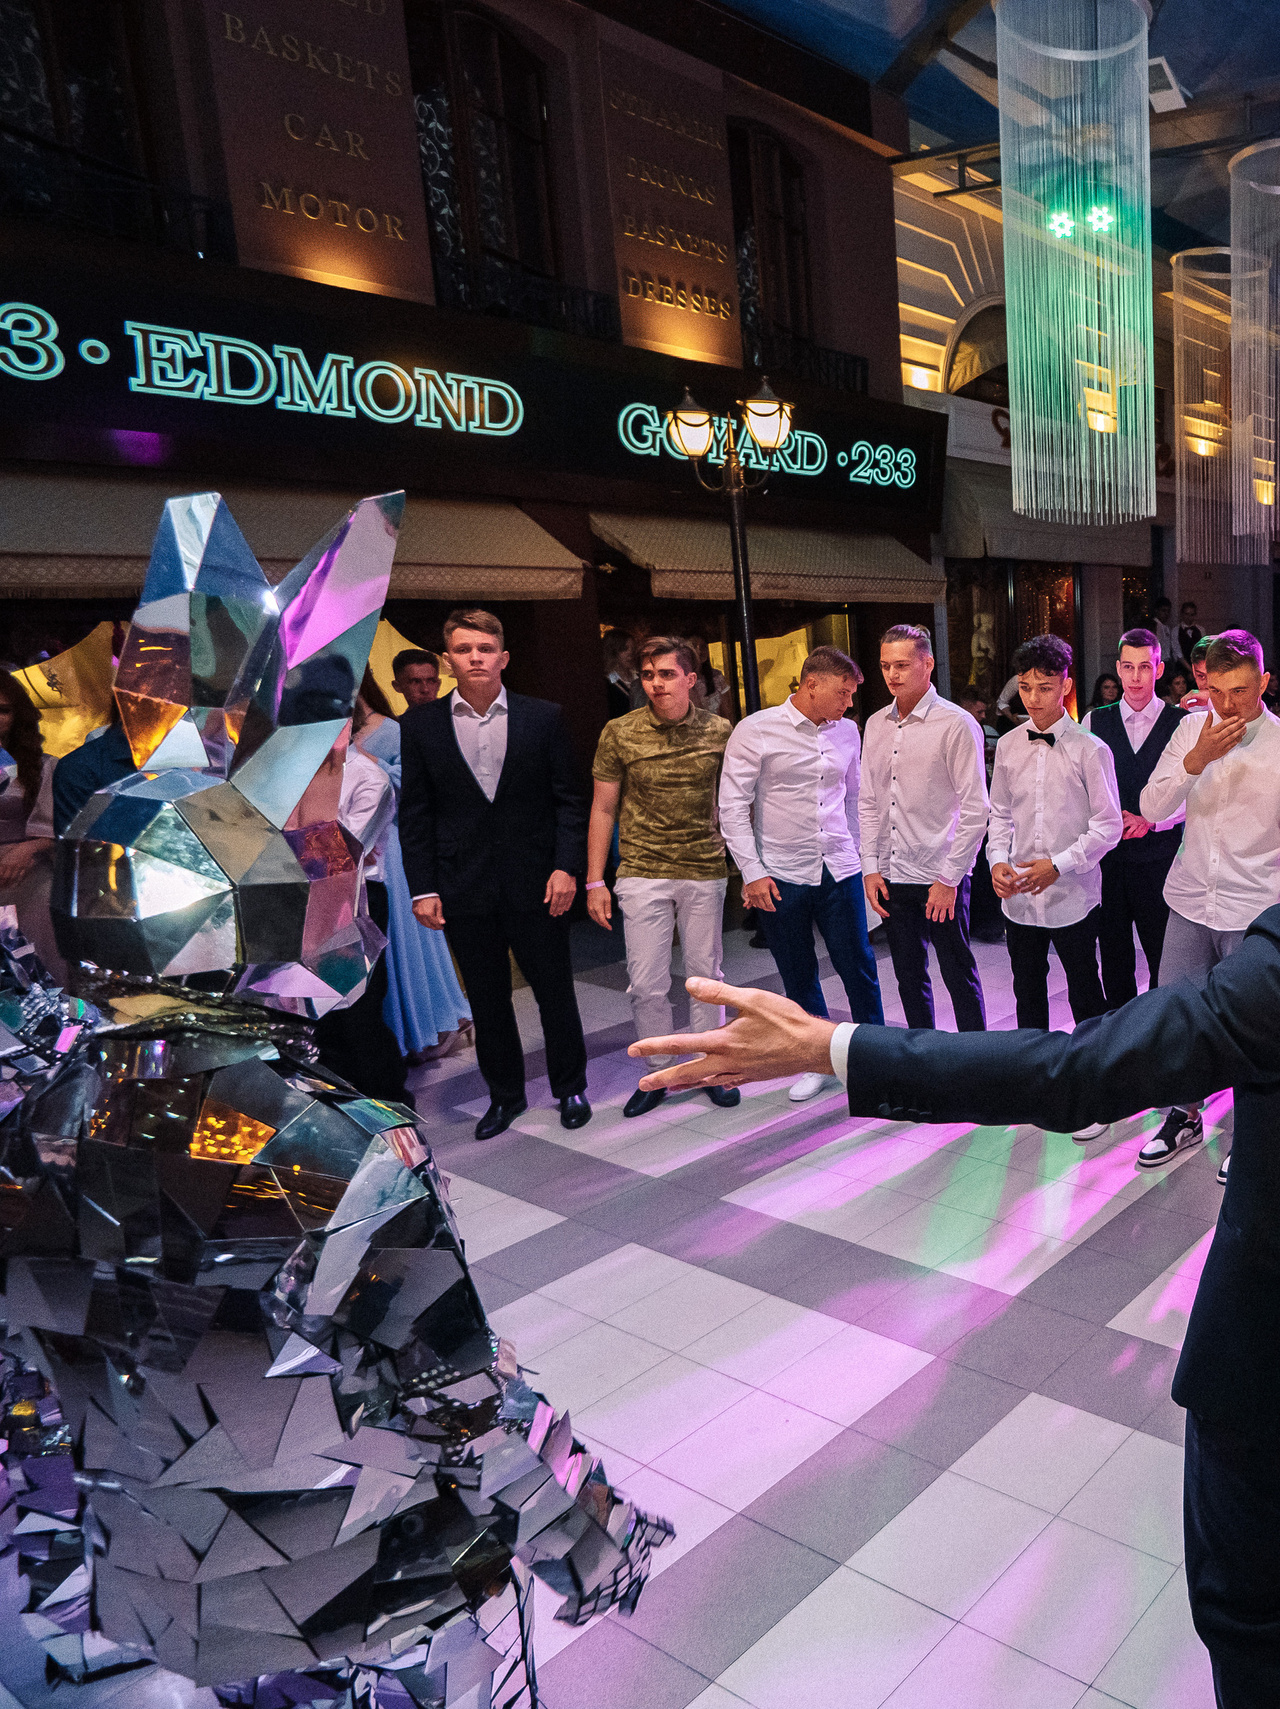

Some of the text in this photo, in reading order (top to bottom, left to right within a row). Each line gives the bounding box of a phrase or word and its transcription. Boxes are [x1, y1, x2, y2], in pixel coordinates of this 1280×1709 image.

[223, 12, 403, 97] BASKETS
[284, 113, 370, 161] CAR
[261, 181, 407, 242] MOTOR
[623, 214, 729, 264] BASKETS
[626, 276, 731, 321] DRESSES
[124, 320, 524, 437] EDMOND
